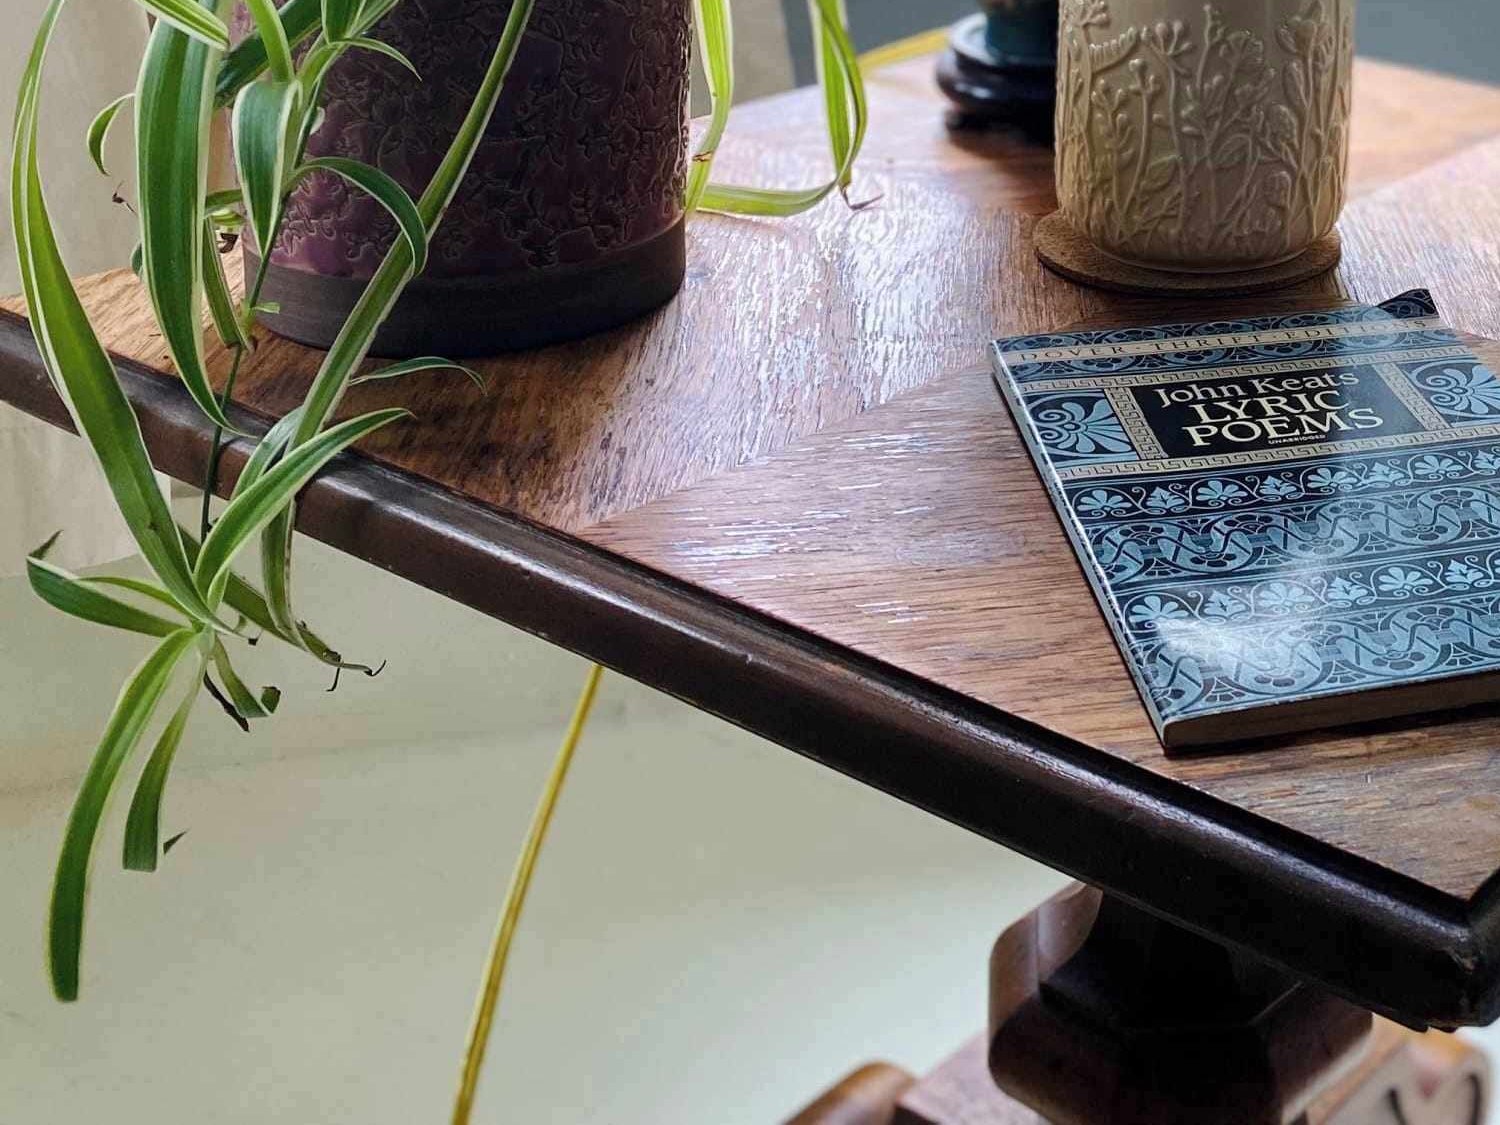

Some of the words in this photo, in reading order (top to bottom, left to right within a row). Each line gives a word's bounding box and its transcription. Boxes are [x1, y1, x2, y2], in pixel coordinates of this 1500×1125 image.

[1020, 345, 1124, 361] DOVER
[1155, 333, 1262, 351] THRIFT
[1154, 377, 1249, 408] John
[1252, 369, 1360, 395] Keats
[1188, 390, 1350, 425] LYRIC
[1182, 407, 1384, 447] POEMS
